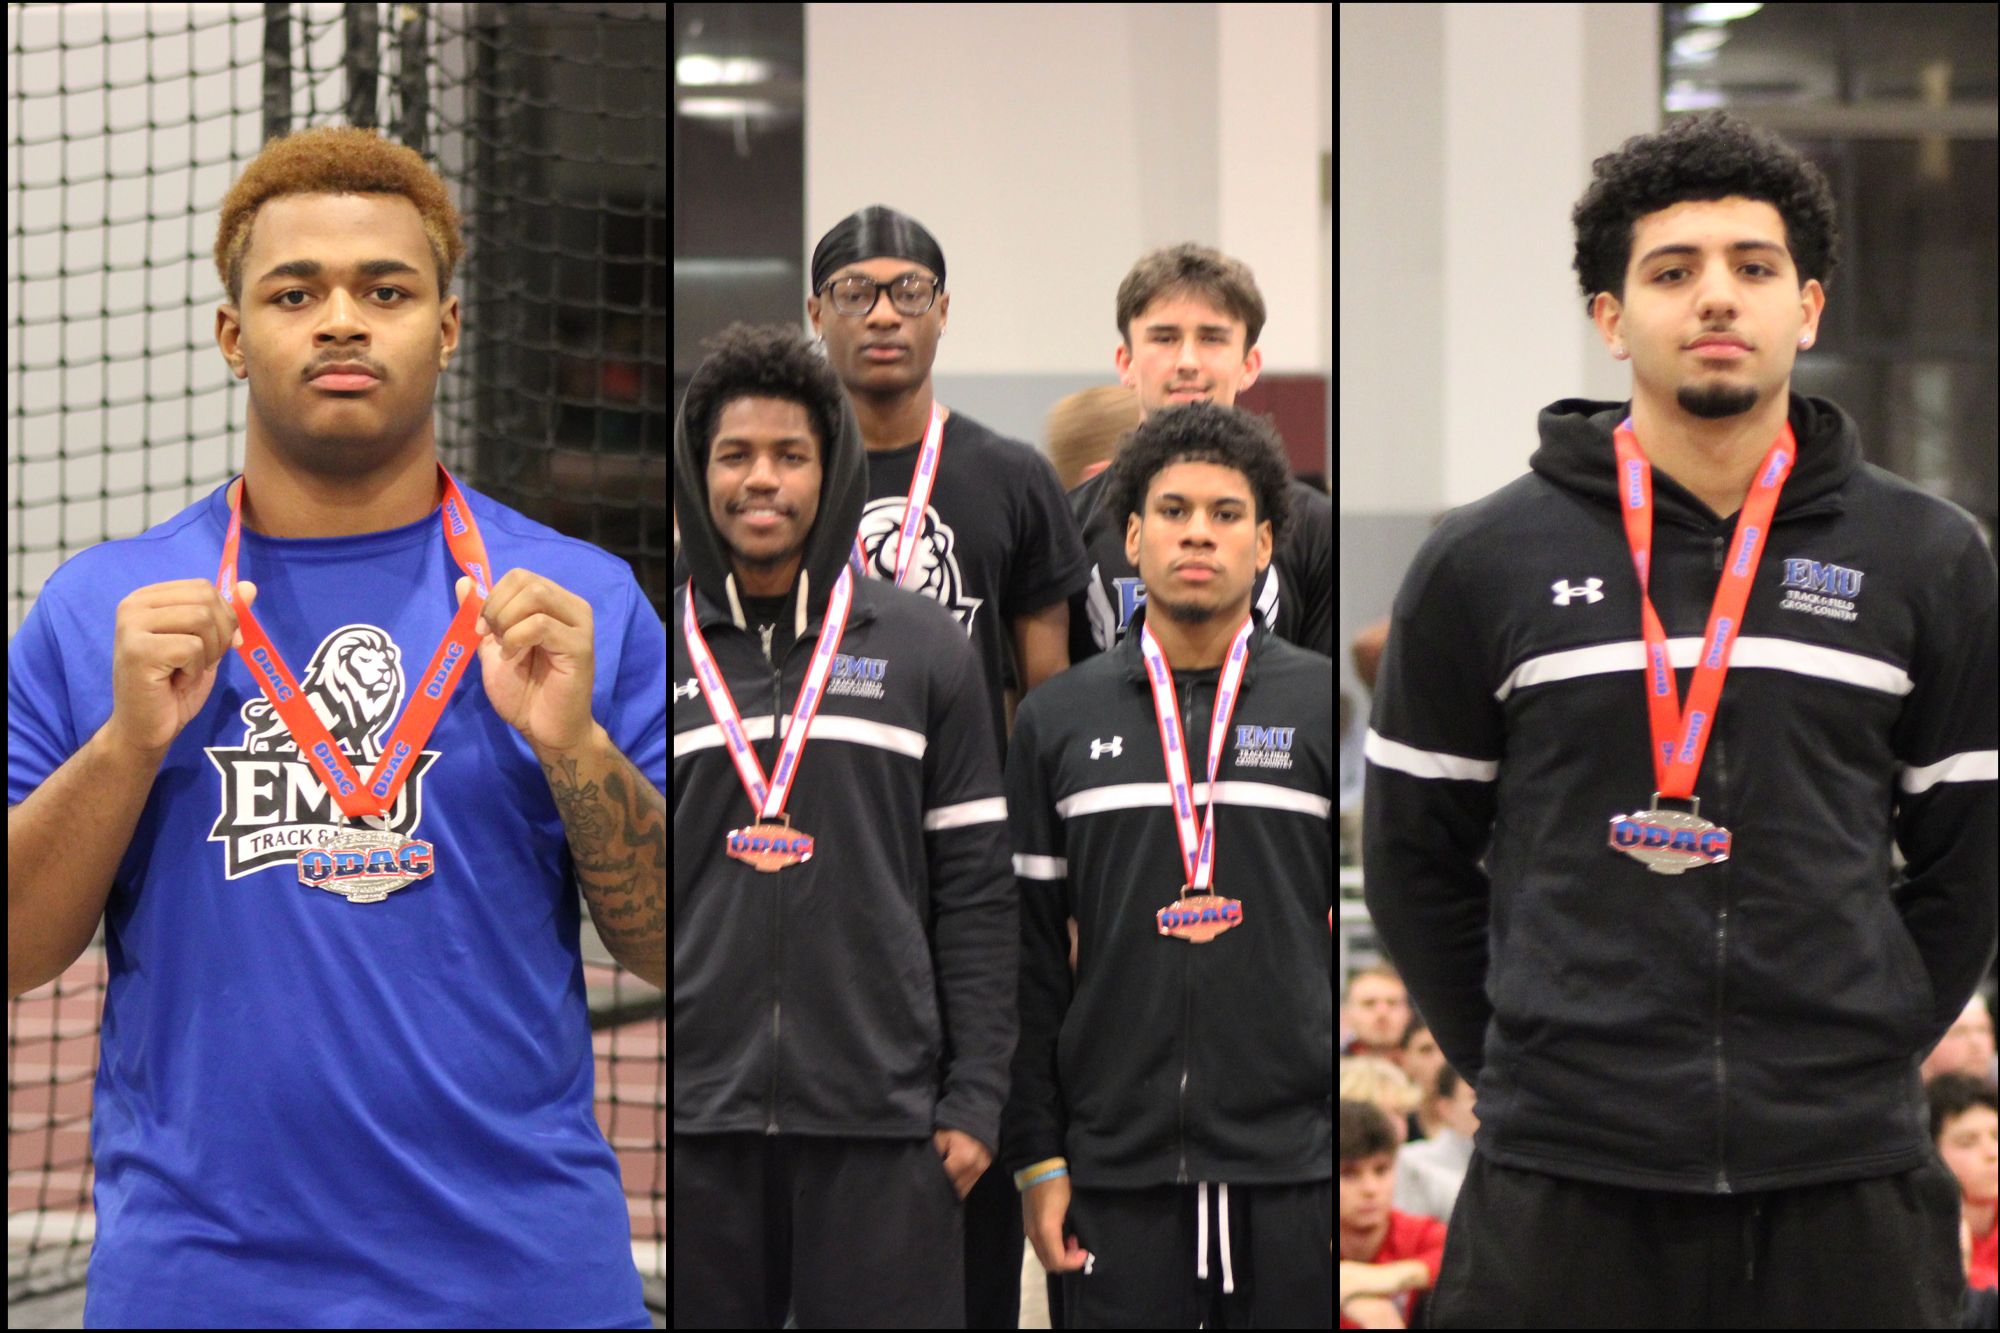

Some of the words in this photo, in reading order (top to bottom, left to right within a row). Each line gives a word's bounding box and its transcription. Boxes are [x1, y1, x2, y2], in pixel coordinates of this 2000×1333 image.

[445, 497, 466, 535] ODAC
[1732, 526, 1759, 577] ODAC
[1780, 558, 1865, 599] EMU
[1786, 590, 1820, 603] TRACK
[1779, 599, 1813, 613] CROSS
[1812, 605, 1858, 622] COUNTRY
[1706, 618, 1732, 669] ODAC
[251, 646, 294, 702] ODAC
[425, 642, 465, 698] ODAC
[830, 653, 888, 682] EMU
[1234, 725, 1296, 751] EMU
[1679, 712, 1705, 764] ODAC
[313, 741, 354, 796] ODAC
[372, 741, 411, 797] ODAC
[250, 829, 314, 854] TRACK
[317, 829, 328, 845] &
[729, 832, 812, 859] ODAC
[1611, 818, 1731, 861] ODAC
[297, 839, 434, 887] ODAC
[1159, 902, 1240, 931] ODAC
